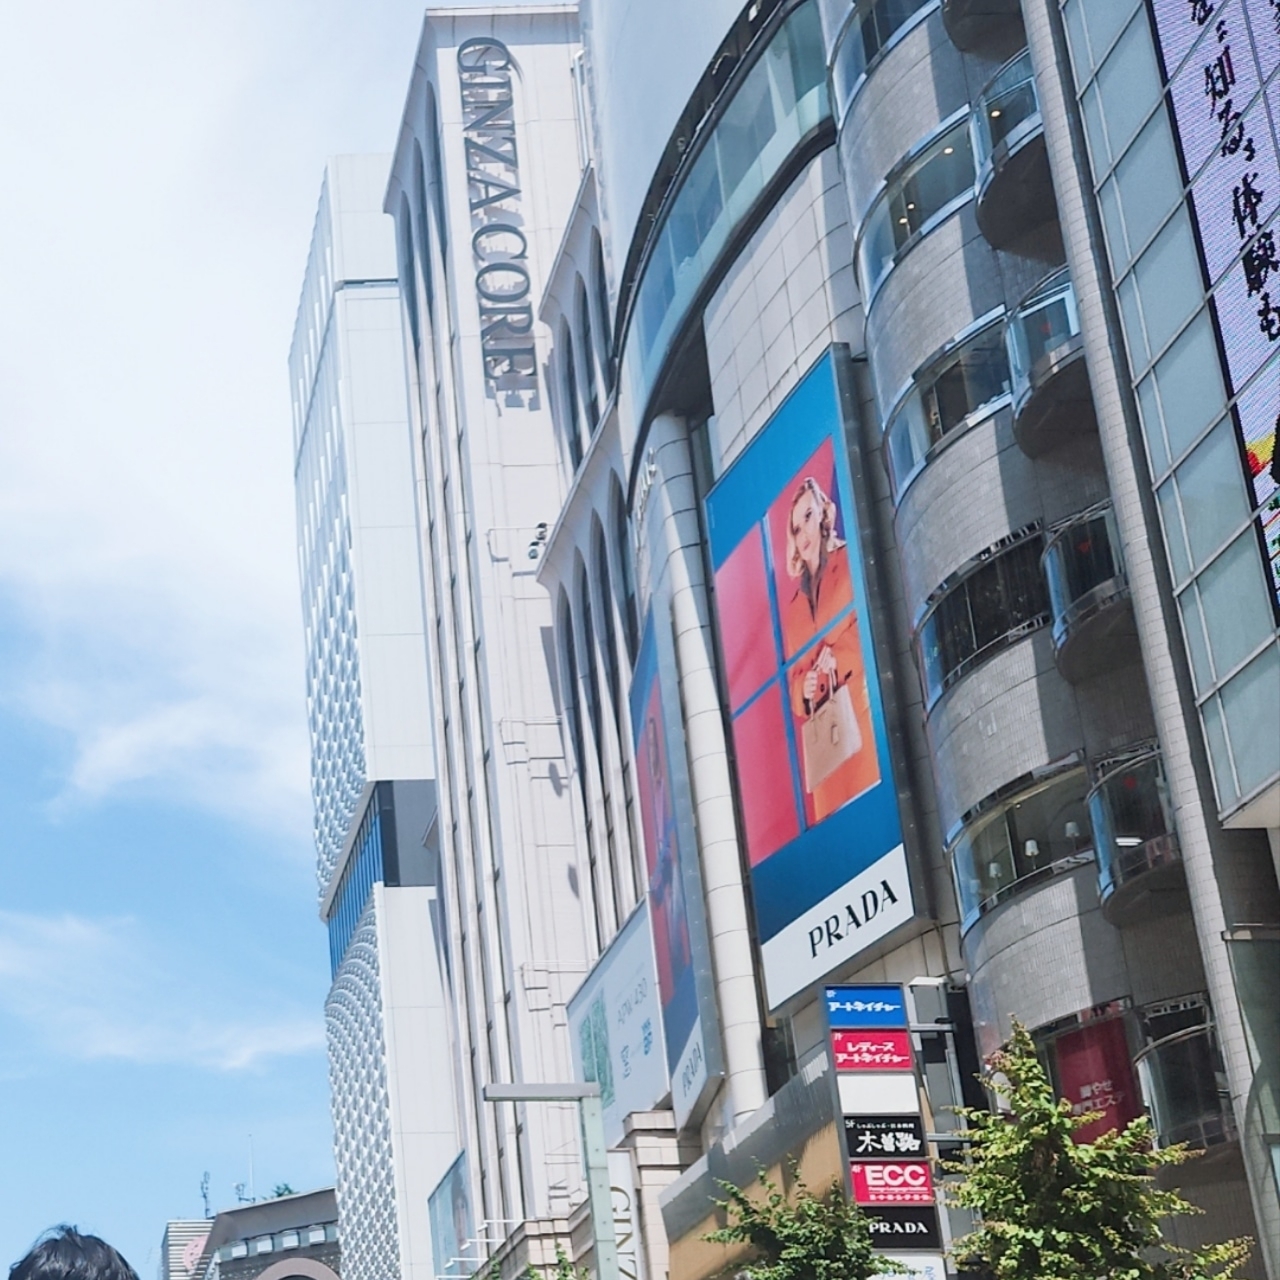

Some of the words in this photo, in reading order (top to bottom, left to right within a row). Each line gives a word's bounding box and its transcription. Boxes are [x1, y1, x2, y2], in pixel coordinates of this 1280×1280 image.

[457, 36, 522, 217] GINZA
[471, 224, 541, 381] CORE
[808, 879, 899, 961] PRADA
[828, 1001, 901, 1012] アートネイチャー
[847, 1041, 896, 1052] レディース
[836, 1053, 910, 1064] アートネイチャー
[864, 1165, 927, 1186] ECC
[868, 1222, 929, 1234] PRADA
